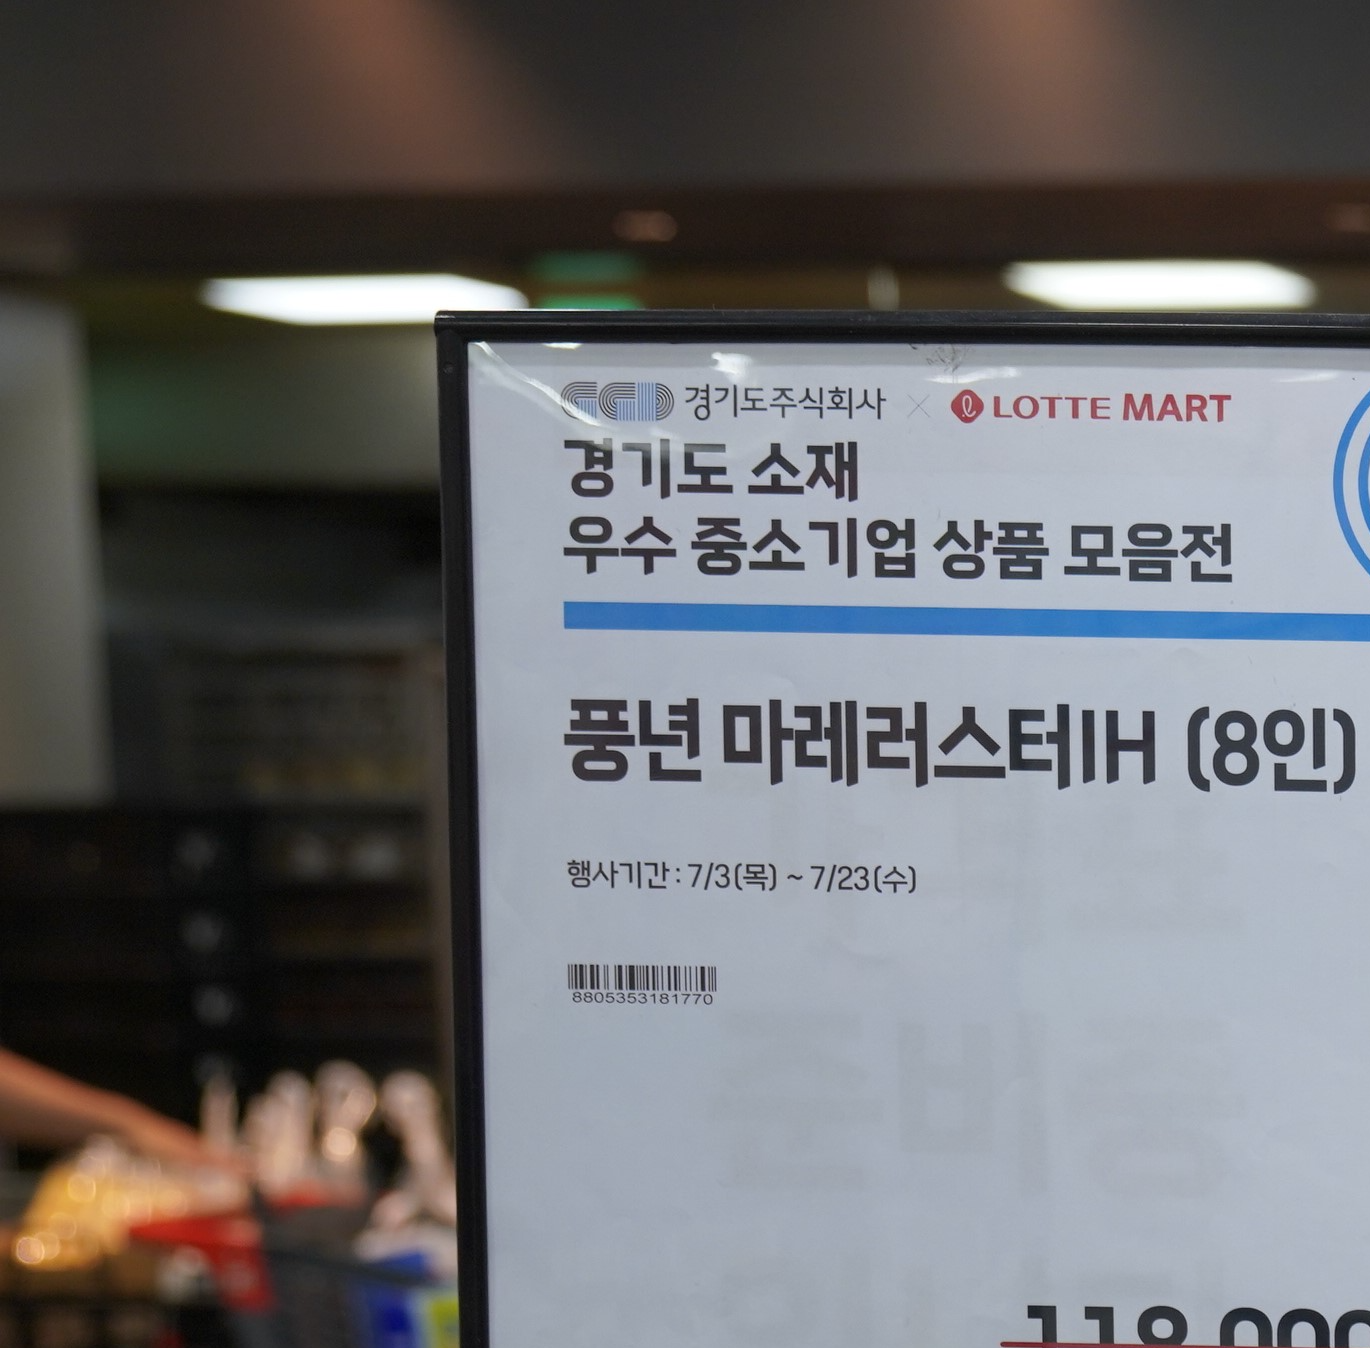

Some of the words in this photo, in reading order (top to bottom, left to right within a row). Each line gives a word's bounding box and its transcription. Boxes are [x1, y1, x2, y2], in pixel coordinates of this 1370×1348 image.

[685, 384, 886, 421] 경기도주식회사
[993, 395, 1111, 420] LOTTE
[1122, 393, 1232, 422] MART
[564, 438, 734, 500] 경기도
[748, 441, 858, 502] 소재
[563, 516, 677, 575] 우수
[690, 517, 916, 579] 중소기업
[933, 519, 1049, 580] 상품
[1064, 523, 1233, 583] 모음전
[564, 698, 702, 782] 풍년
[722, 698, 1156, 790] 마레러스터IH
[1187, 706, 1356, 795] (8인)
[687, 862, 777, 892] 7/3(목)
[810, 864, 917, 894] 7/23(수)
[572, 991, 714, 1006] 8805353181770
